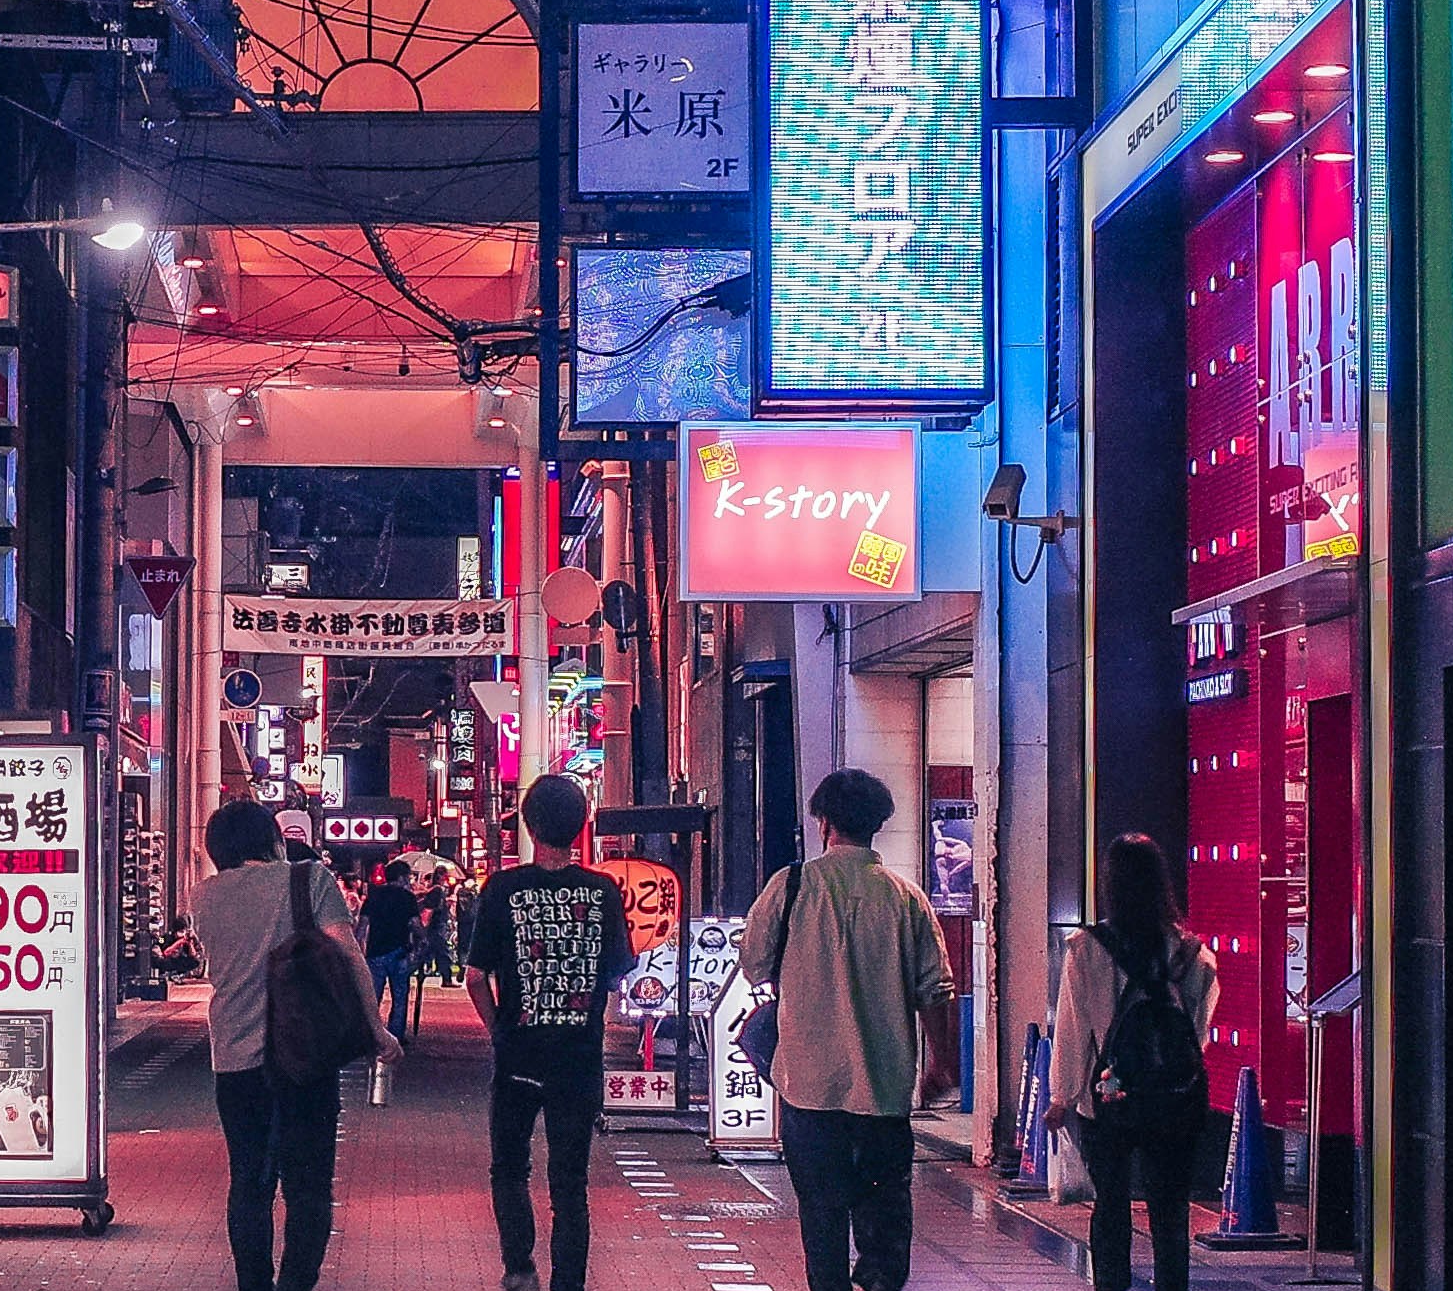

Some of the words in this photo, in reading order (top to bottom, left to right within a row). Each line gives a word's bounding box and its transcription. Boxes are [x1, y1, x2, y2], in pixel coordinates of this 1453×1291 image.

[594, 52, 684, 74] ギャラリー
[601, 88, 727, 140] 米原
[705, 157, 741, 179] 2F
[712, 479, 892, 531] K-story
[140, 568, 181, 584] 止まれ
[508, 886, 604, 908] CHROME
[607, 1075, 670, 1100] 営業中
[721, 1109, 767, 1129] 3F
